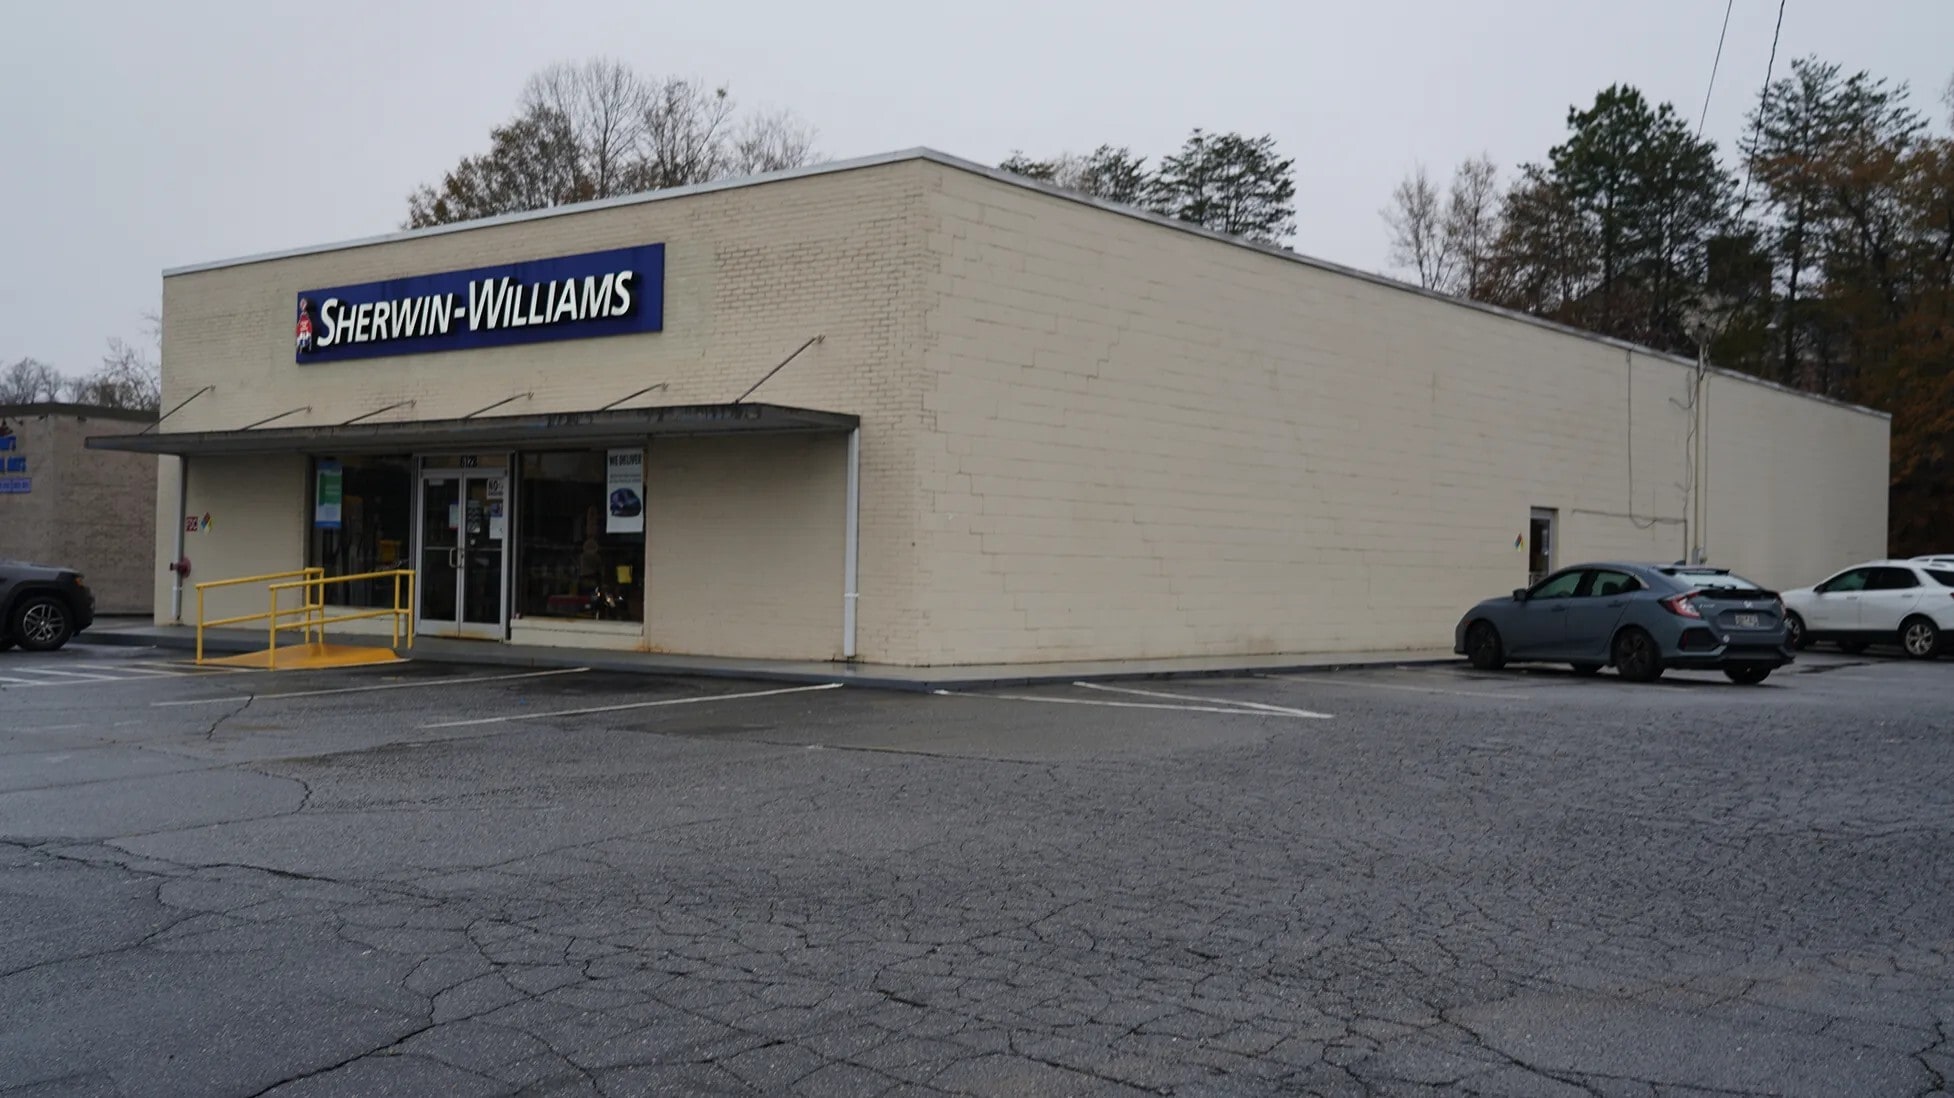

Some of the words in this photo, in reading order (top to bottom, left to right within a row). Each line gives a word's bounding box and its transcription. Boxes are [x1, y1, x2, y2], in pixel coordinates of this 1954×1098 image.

[316, 270, 633, 347] SHERWIN-WILLIAMS
[609, 456, 618, 466] WE
[619, 454, 642, 465] DELIVER
